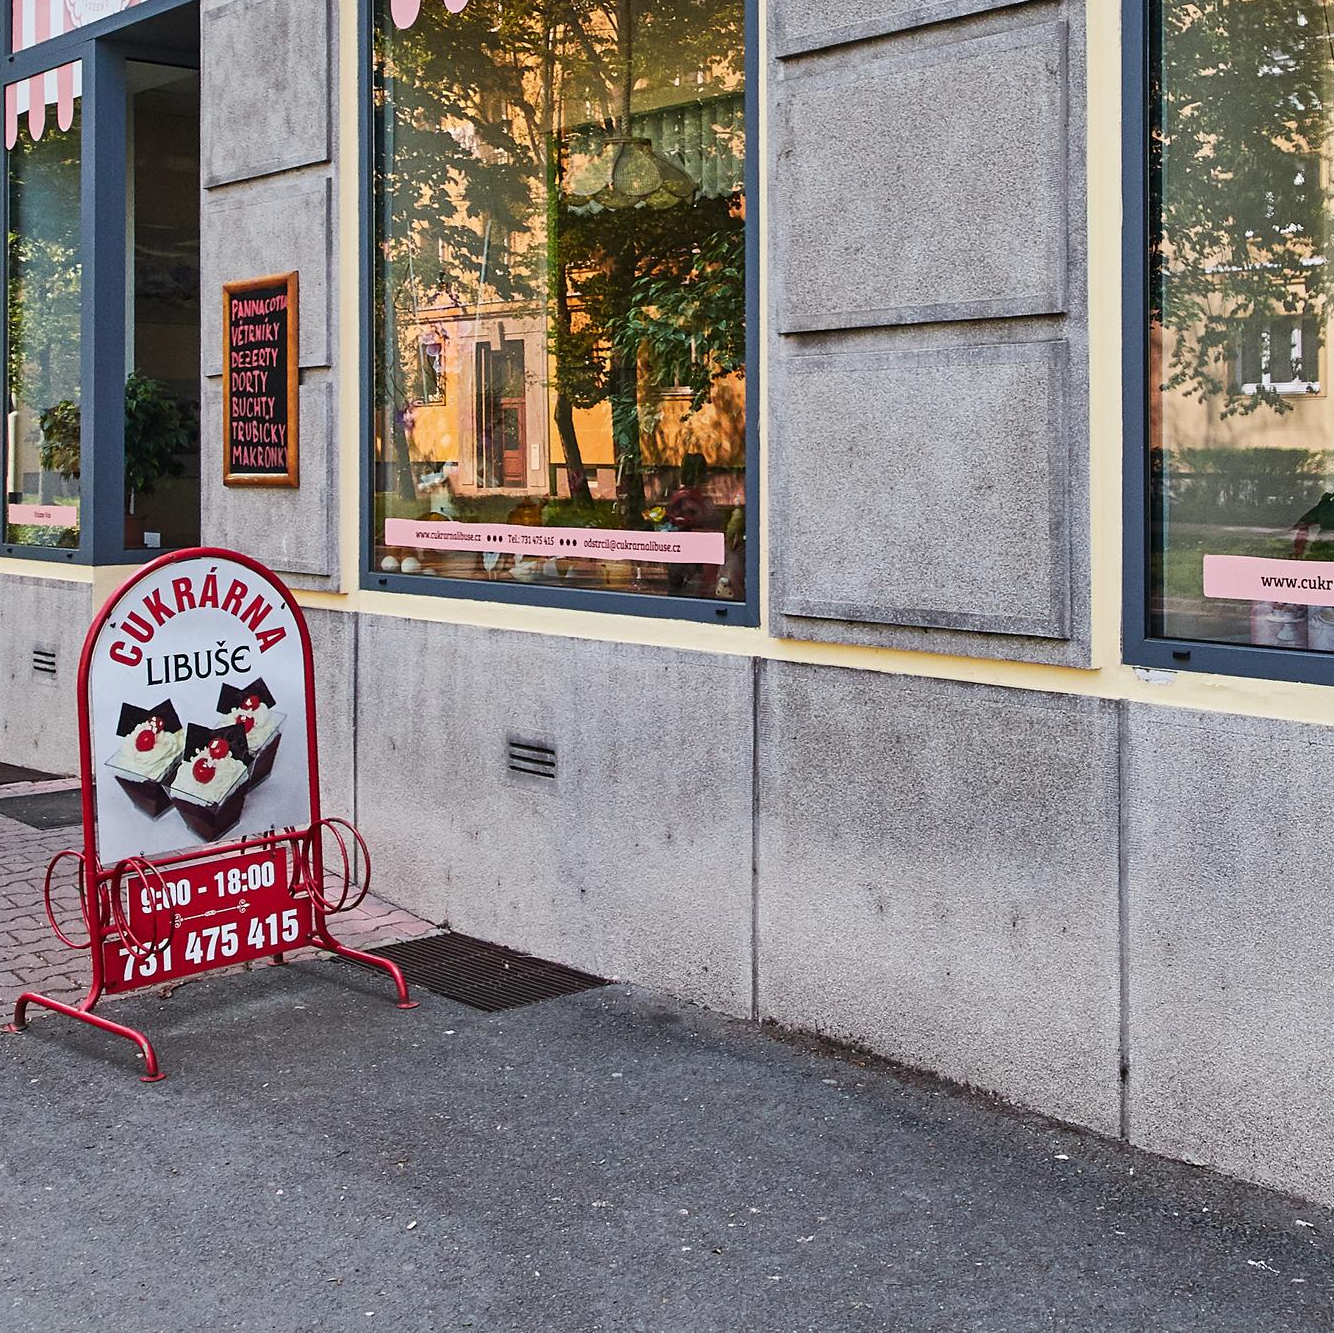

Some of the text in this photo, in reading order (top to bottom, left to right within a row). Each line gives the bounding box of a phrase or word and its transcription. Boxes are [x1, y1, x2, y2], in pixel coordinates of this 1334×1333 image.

[231, 347, 278, 368] DEZERTY
[231, 370, 268, 393] DORTY
[232, 396, 275, 418] BUCHTY
[415, 531, 481, 542] www.cukrarnalibuse.cz
[521, 535, 531, 544] 731
[544, 536, 554, 546] 415
[583, 537, 681, 552] odstrcil@cukrarnalibuse.cz
[109, 566, 287, 667] CUKRÁRNA
[146, 640, 252, 686] LIBUŠE
[140, 878, 192, 914] 9:00
[214, 861, 275, 898] 18:00
[119, 908, 299, 982] 731 475 415
